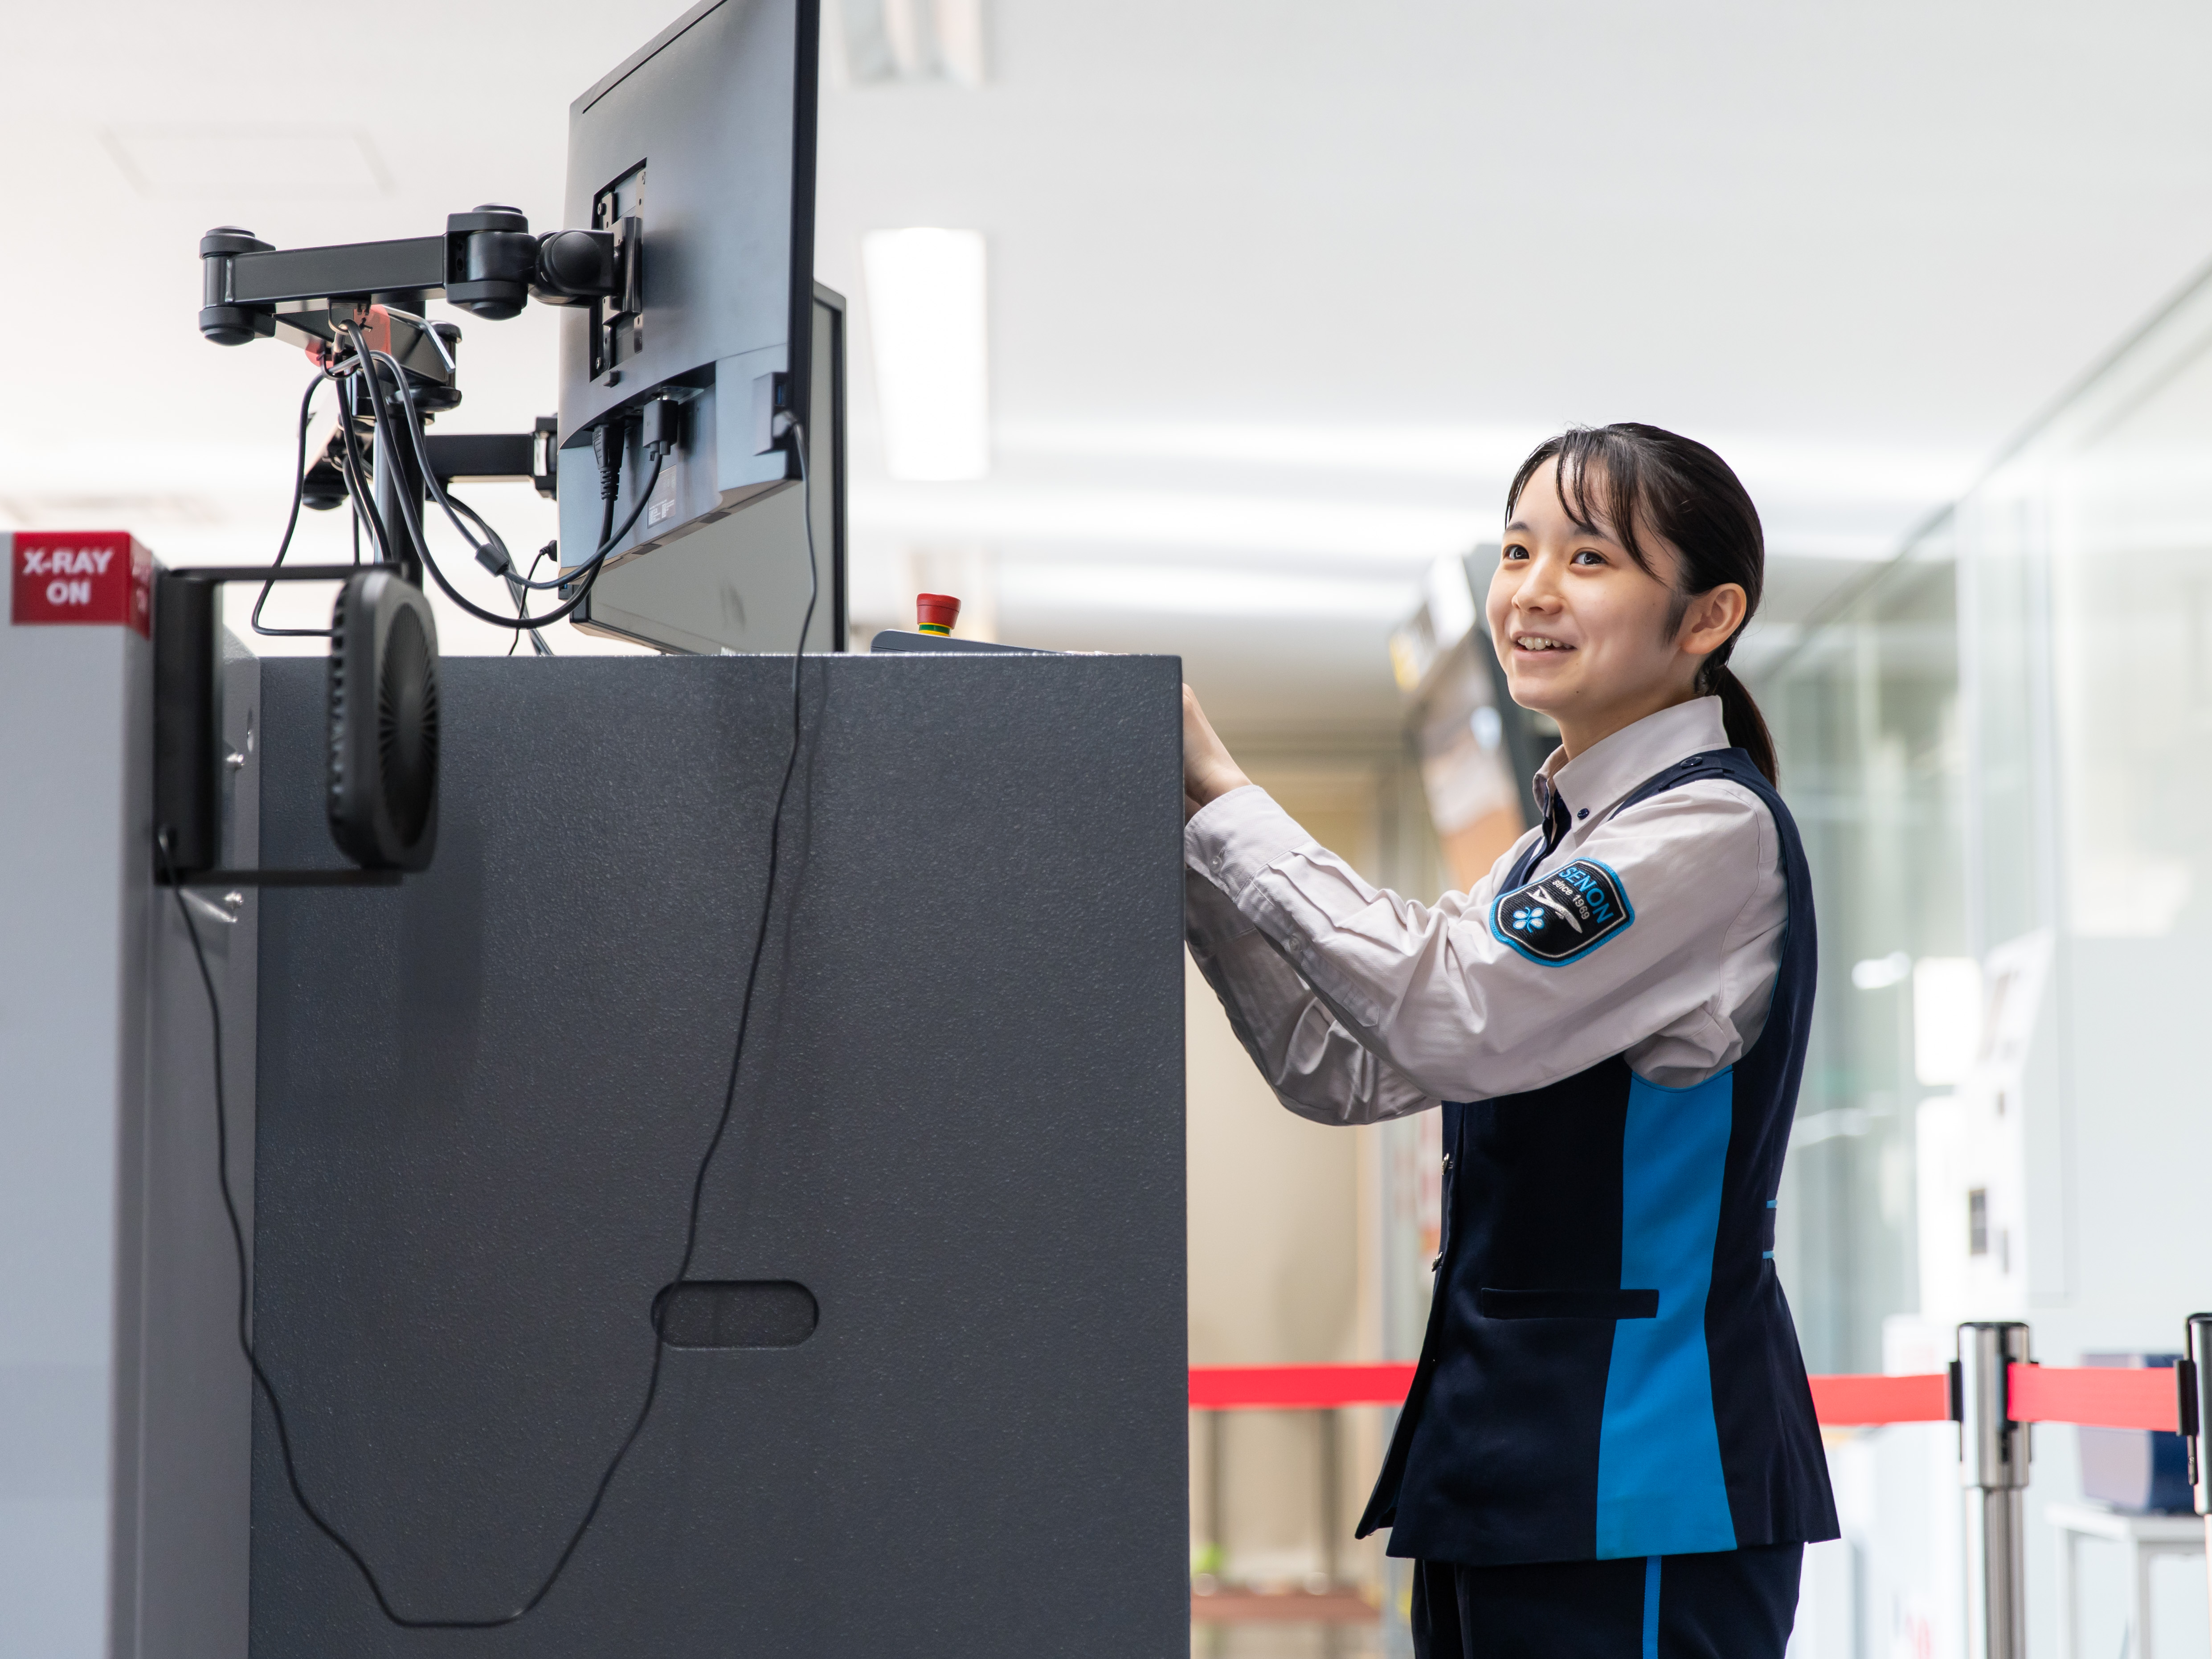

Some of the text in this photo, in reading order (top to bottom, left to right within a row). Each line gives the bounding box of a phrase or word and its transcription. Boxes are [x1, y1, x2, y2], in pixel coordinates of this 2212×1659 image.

[24, 548, 114, 575] X-RAY
[46, 580, 90, 605] ON
[1552, 880, 1590, 919] since 1969
[1558, 866, 1614, 923] SENON
